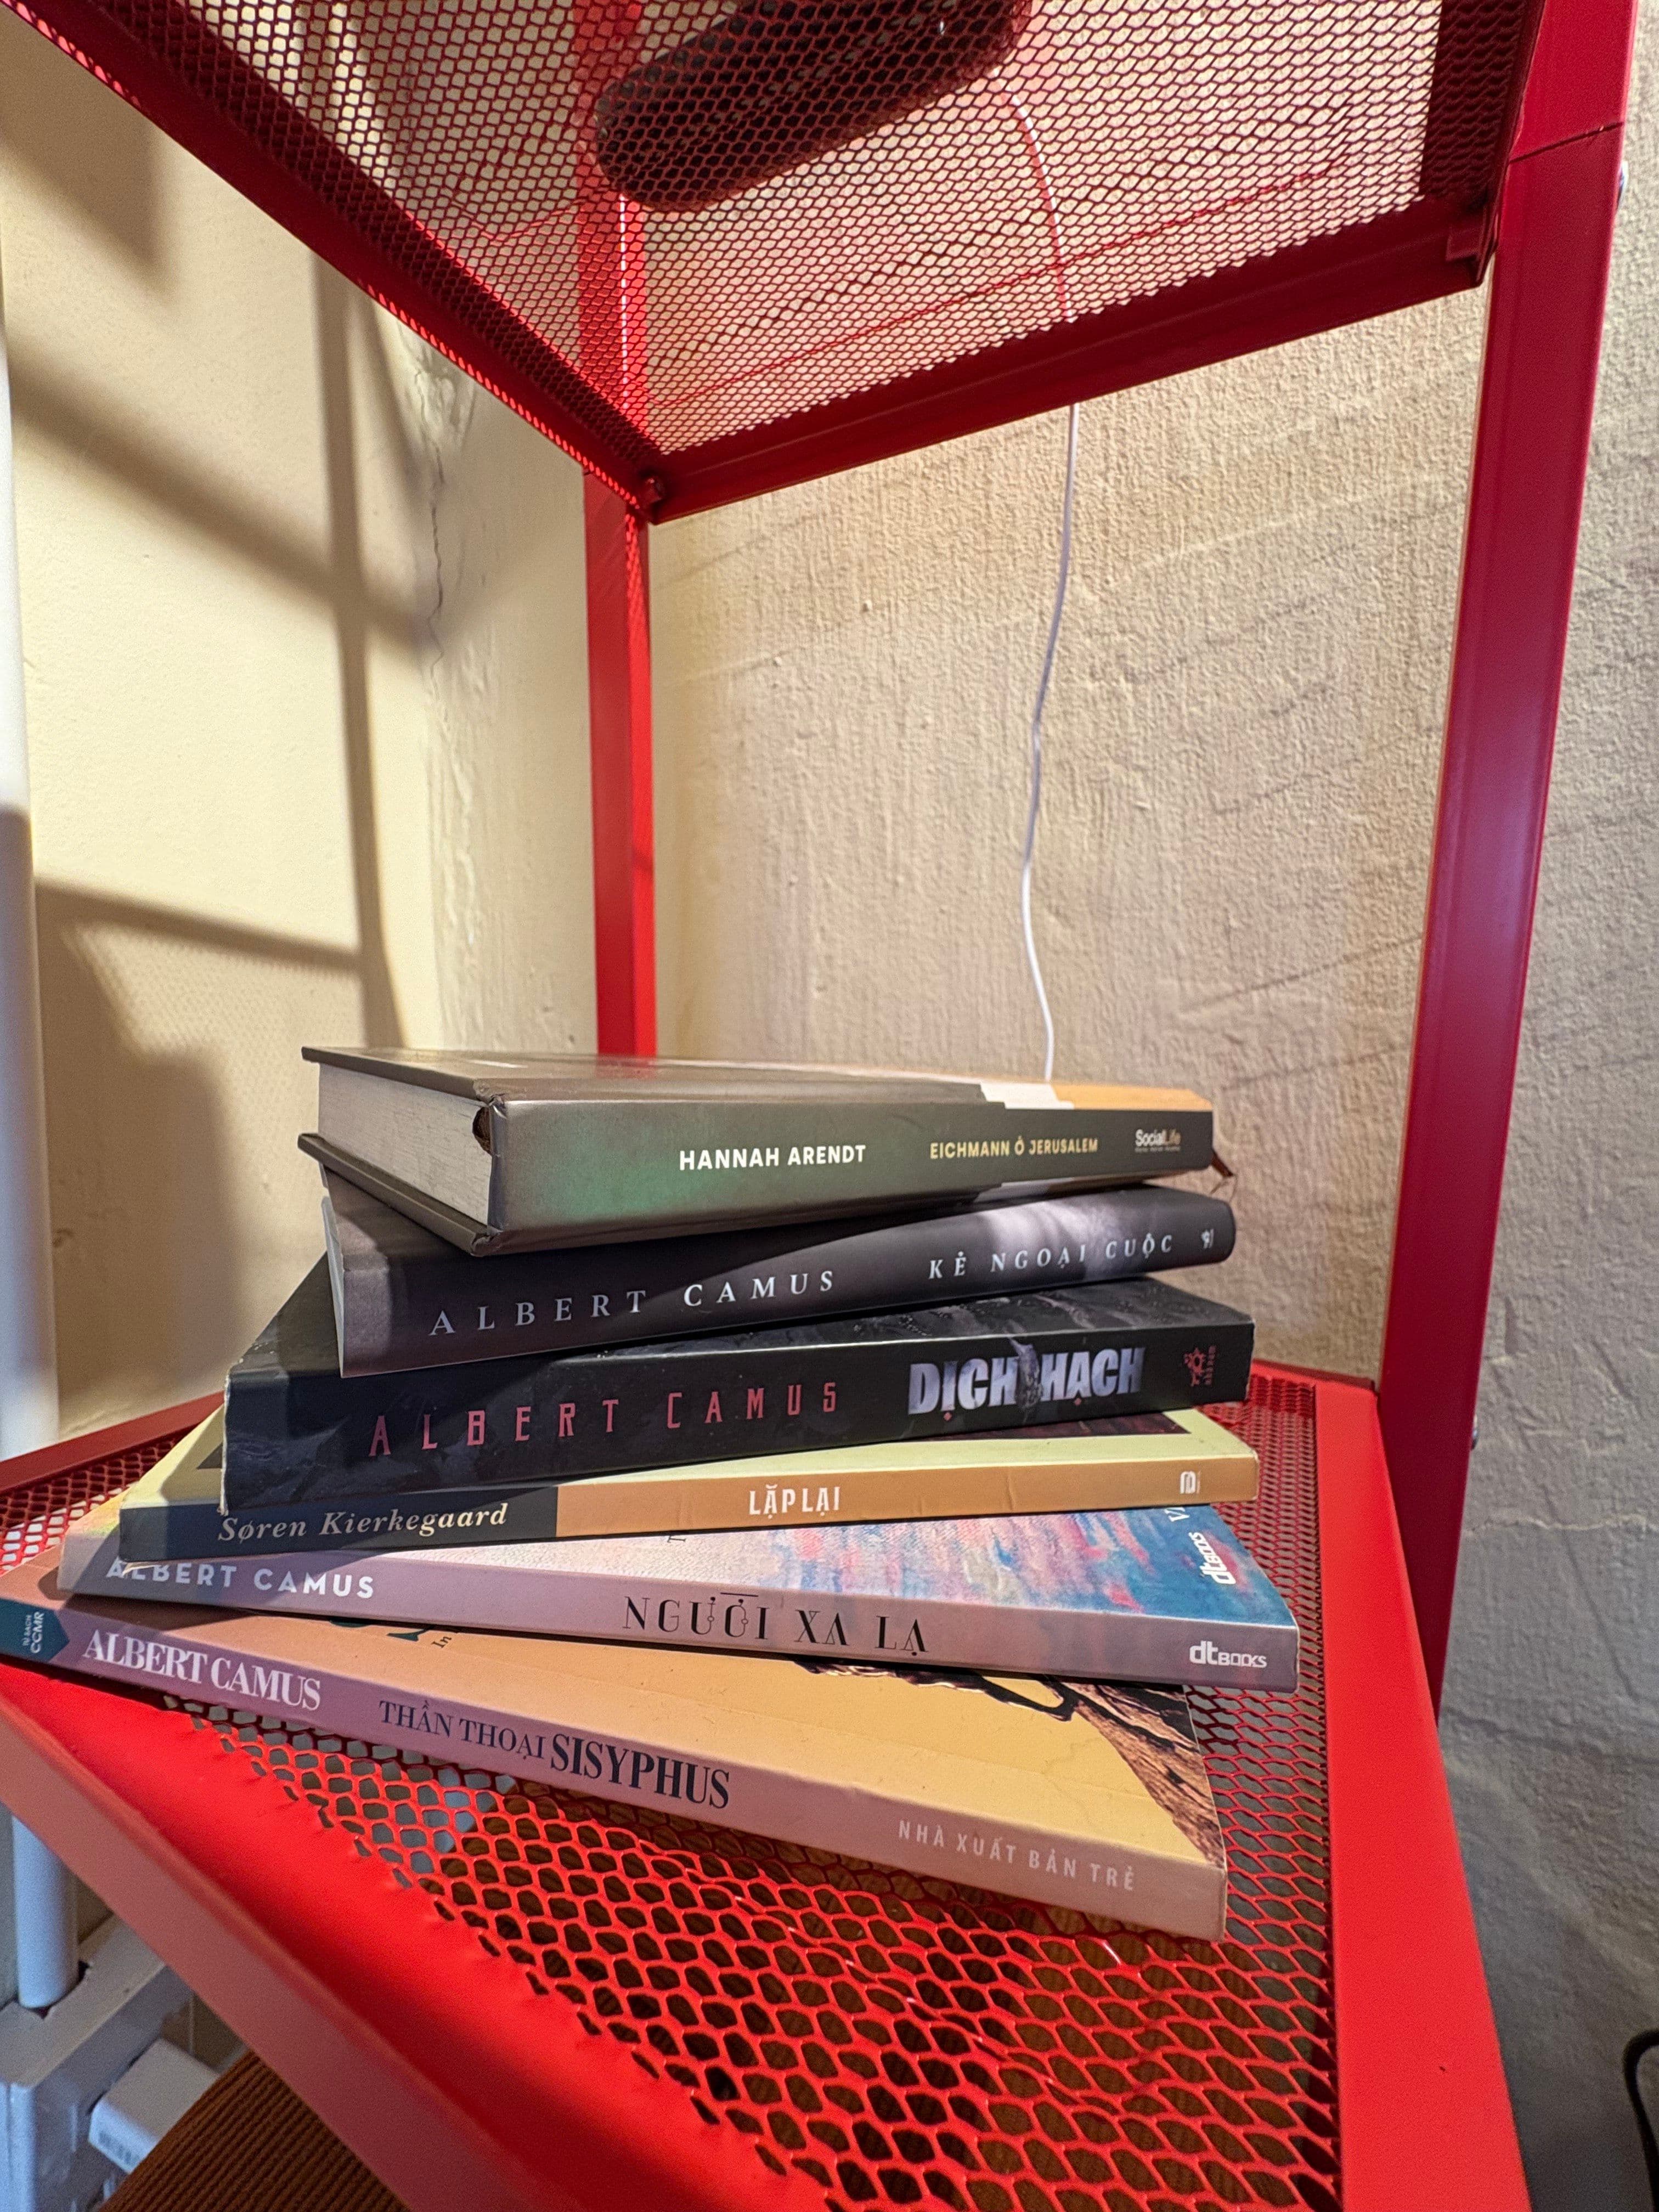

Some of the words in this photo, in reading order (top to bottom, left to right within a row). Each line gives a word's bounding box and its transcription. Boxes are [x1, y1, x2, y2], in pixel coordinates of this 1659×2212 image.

[679, 1147, 779, 1171] HANNAH
[788, 1144, 866, 1166] ARENDT
[930, 1140, 1009, 1159] EICHMANN
[1029, 1137, 1098, 1155] JERUSALEM
[928, 1251, 967, 1279] KẺ
[990, 1244, 1086, 1273] NGOẠI
[1105, 1233, 1173, 1260] CUỘC
[428, 1289, 646, 1336] ALBERT
[684, 1270, 834, 1307] CAMUS
[908, 1356, 1019, 1421] DỊCH
[1041, 1347, 1146, 1406] HẠCH
[368, 1399, 619, 1457] ALBERT
[666, 1382, 837, 1429] CAMUS
[218, 1517, 307, 1543] Søren
[319, 1503, 508, 1537] Kierkegaard
[749, 1483, 795, 1519] LẶP
[802, 1486, 840, 1516] LẠI
[106, 1555, 237, 1588] ALBERT
[254, 1567, 374, 1599] CAMUS
[30, 1611, 45, 1654] CCMR
[430, 1635, 452, 1649] In
[794, 1609, 850, 1646] XA
[874, 1615, 929, 1656] LẠ
[81, 1628, 207, 1685] ALBERT
[210, 1657, 321, 1711] CAMUS
[379, 1699, 452, 1738] THẦN
[459, 1718, 544, 1762] THOẠI
[550, 1733, 730, 1809] SISYPHUS
[899, 1820, 944, 1848] NHÀ
[956, 1833, 1016, 1864] XUẤT
[1029, 1848, 1076, 1878] BẢN
[1090, 1863, 1133, 1891] TRẺ
